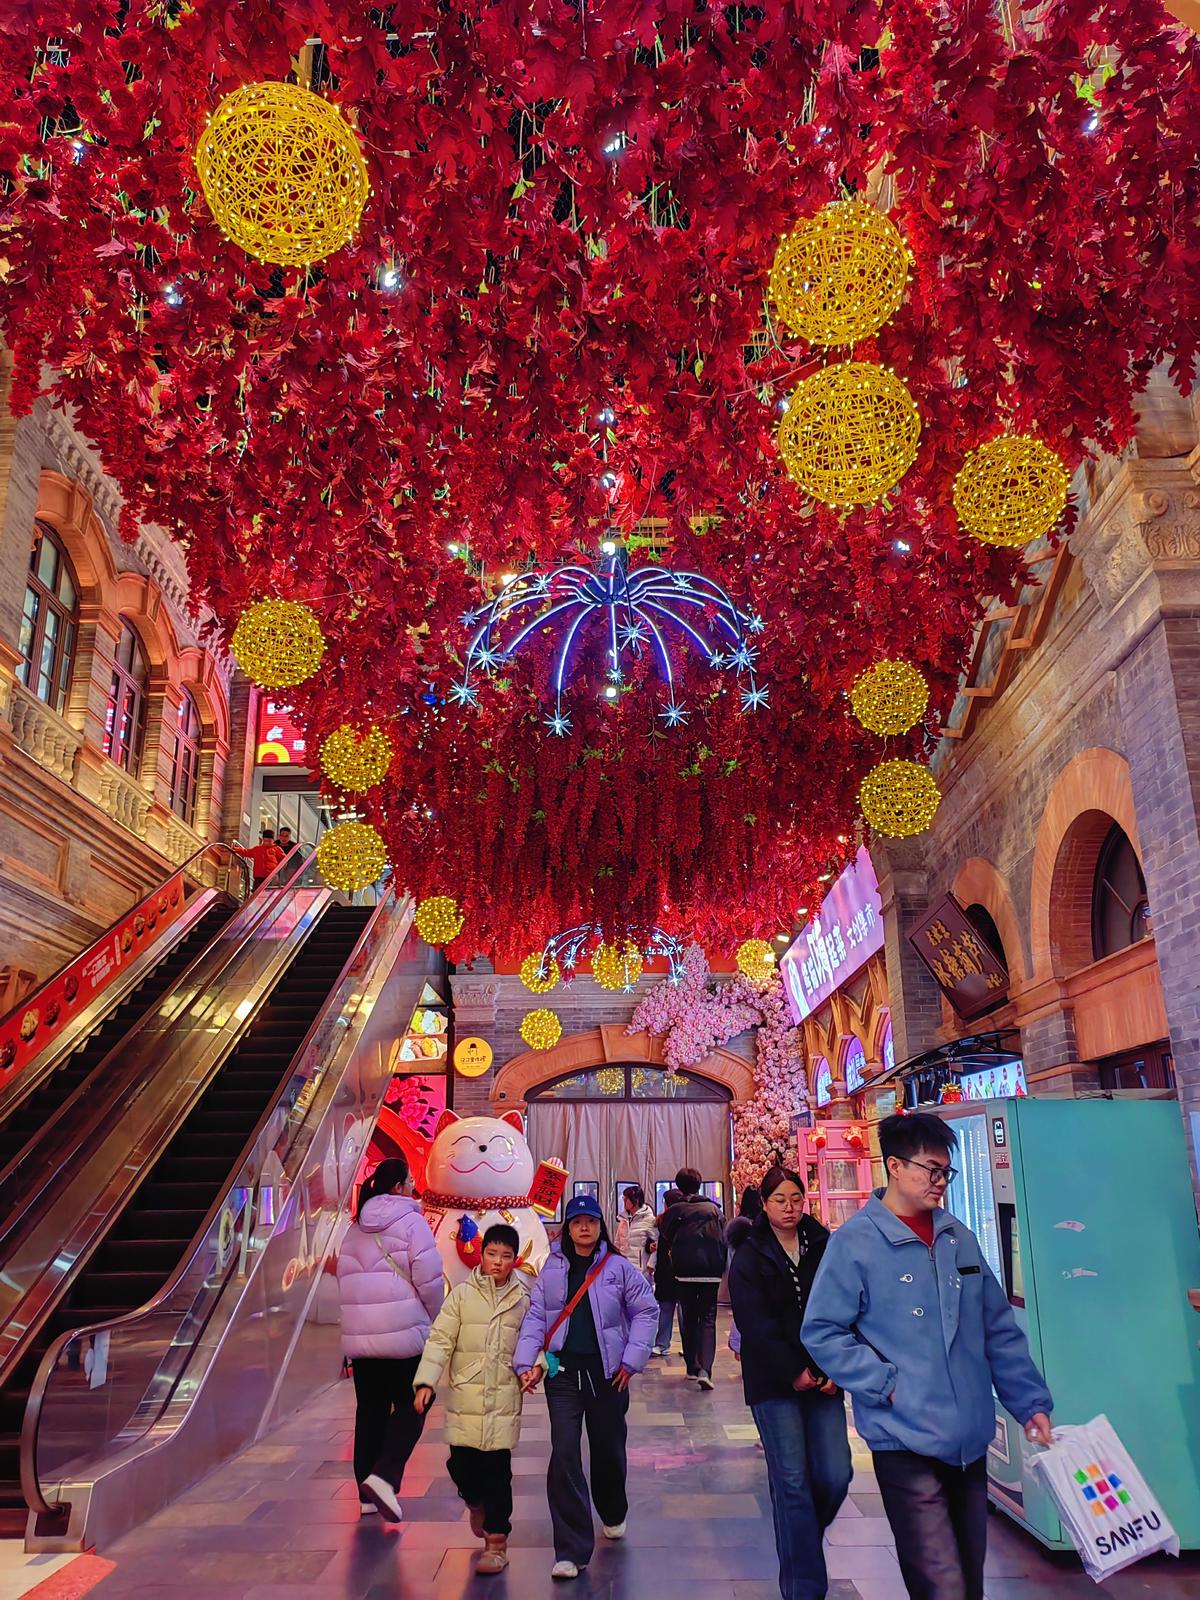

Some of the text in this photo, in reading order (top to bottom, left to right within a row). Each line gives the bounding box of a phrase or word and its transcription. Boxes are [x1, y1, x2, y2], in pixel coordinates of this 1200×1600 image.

[932, 930, 983, 988] 冰糖葫芦
[1095, 1510, 1161, 1556] SANFU
